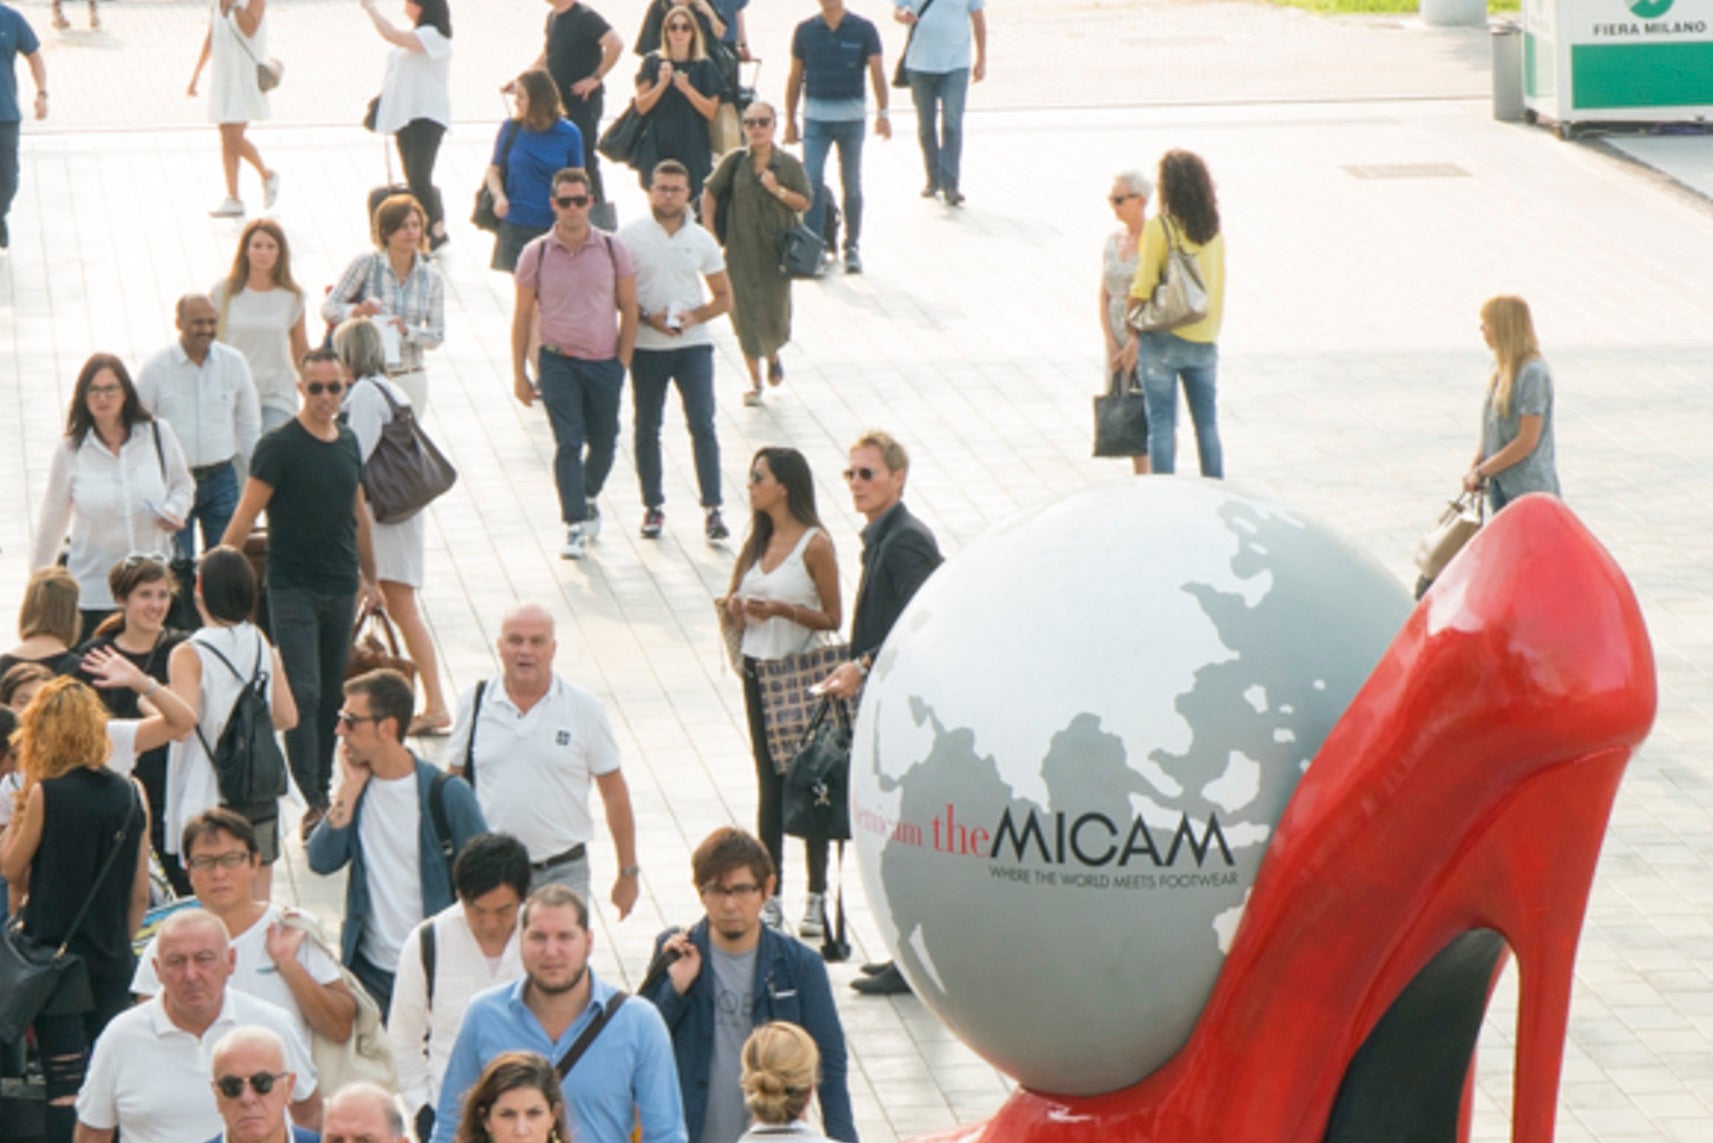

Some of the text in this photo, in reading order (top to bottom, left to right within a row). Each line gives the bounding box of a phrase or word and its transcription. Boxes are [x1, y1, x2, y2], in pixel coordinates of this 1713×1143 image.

[1593, 20, 1707, 36] FIERA MILANO
[989, 866, 1238, 890] WHERE THE WORLD MEETS FOOTWEAR
